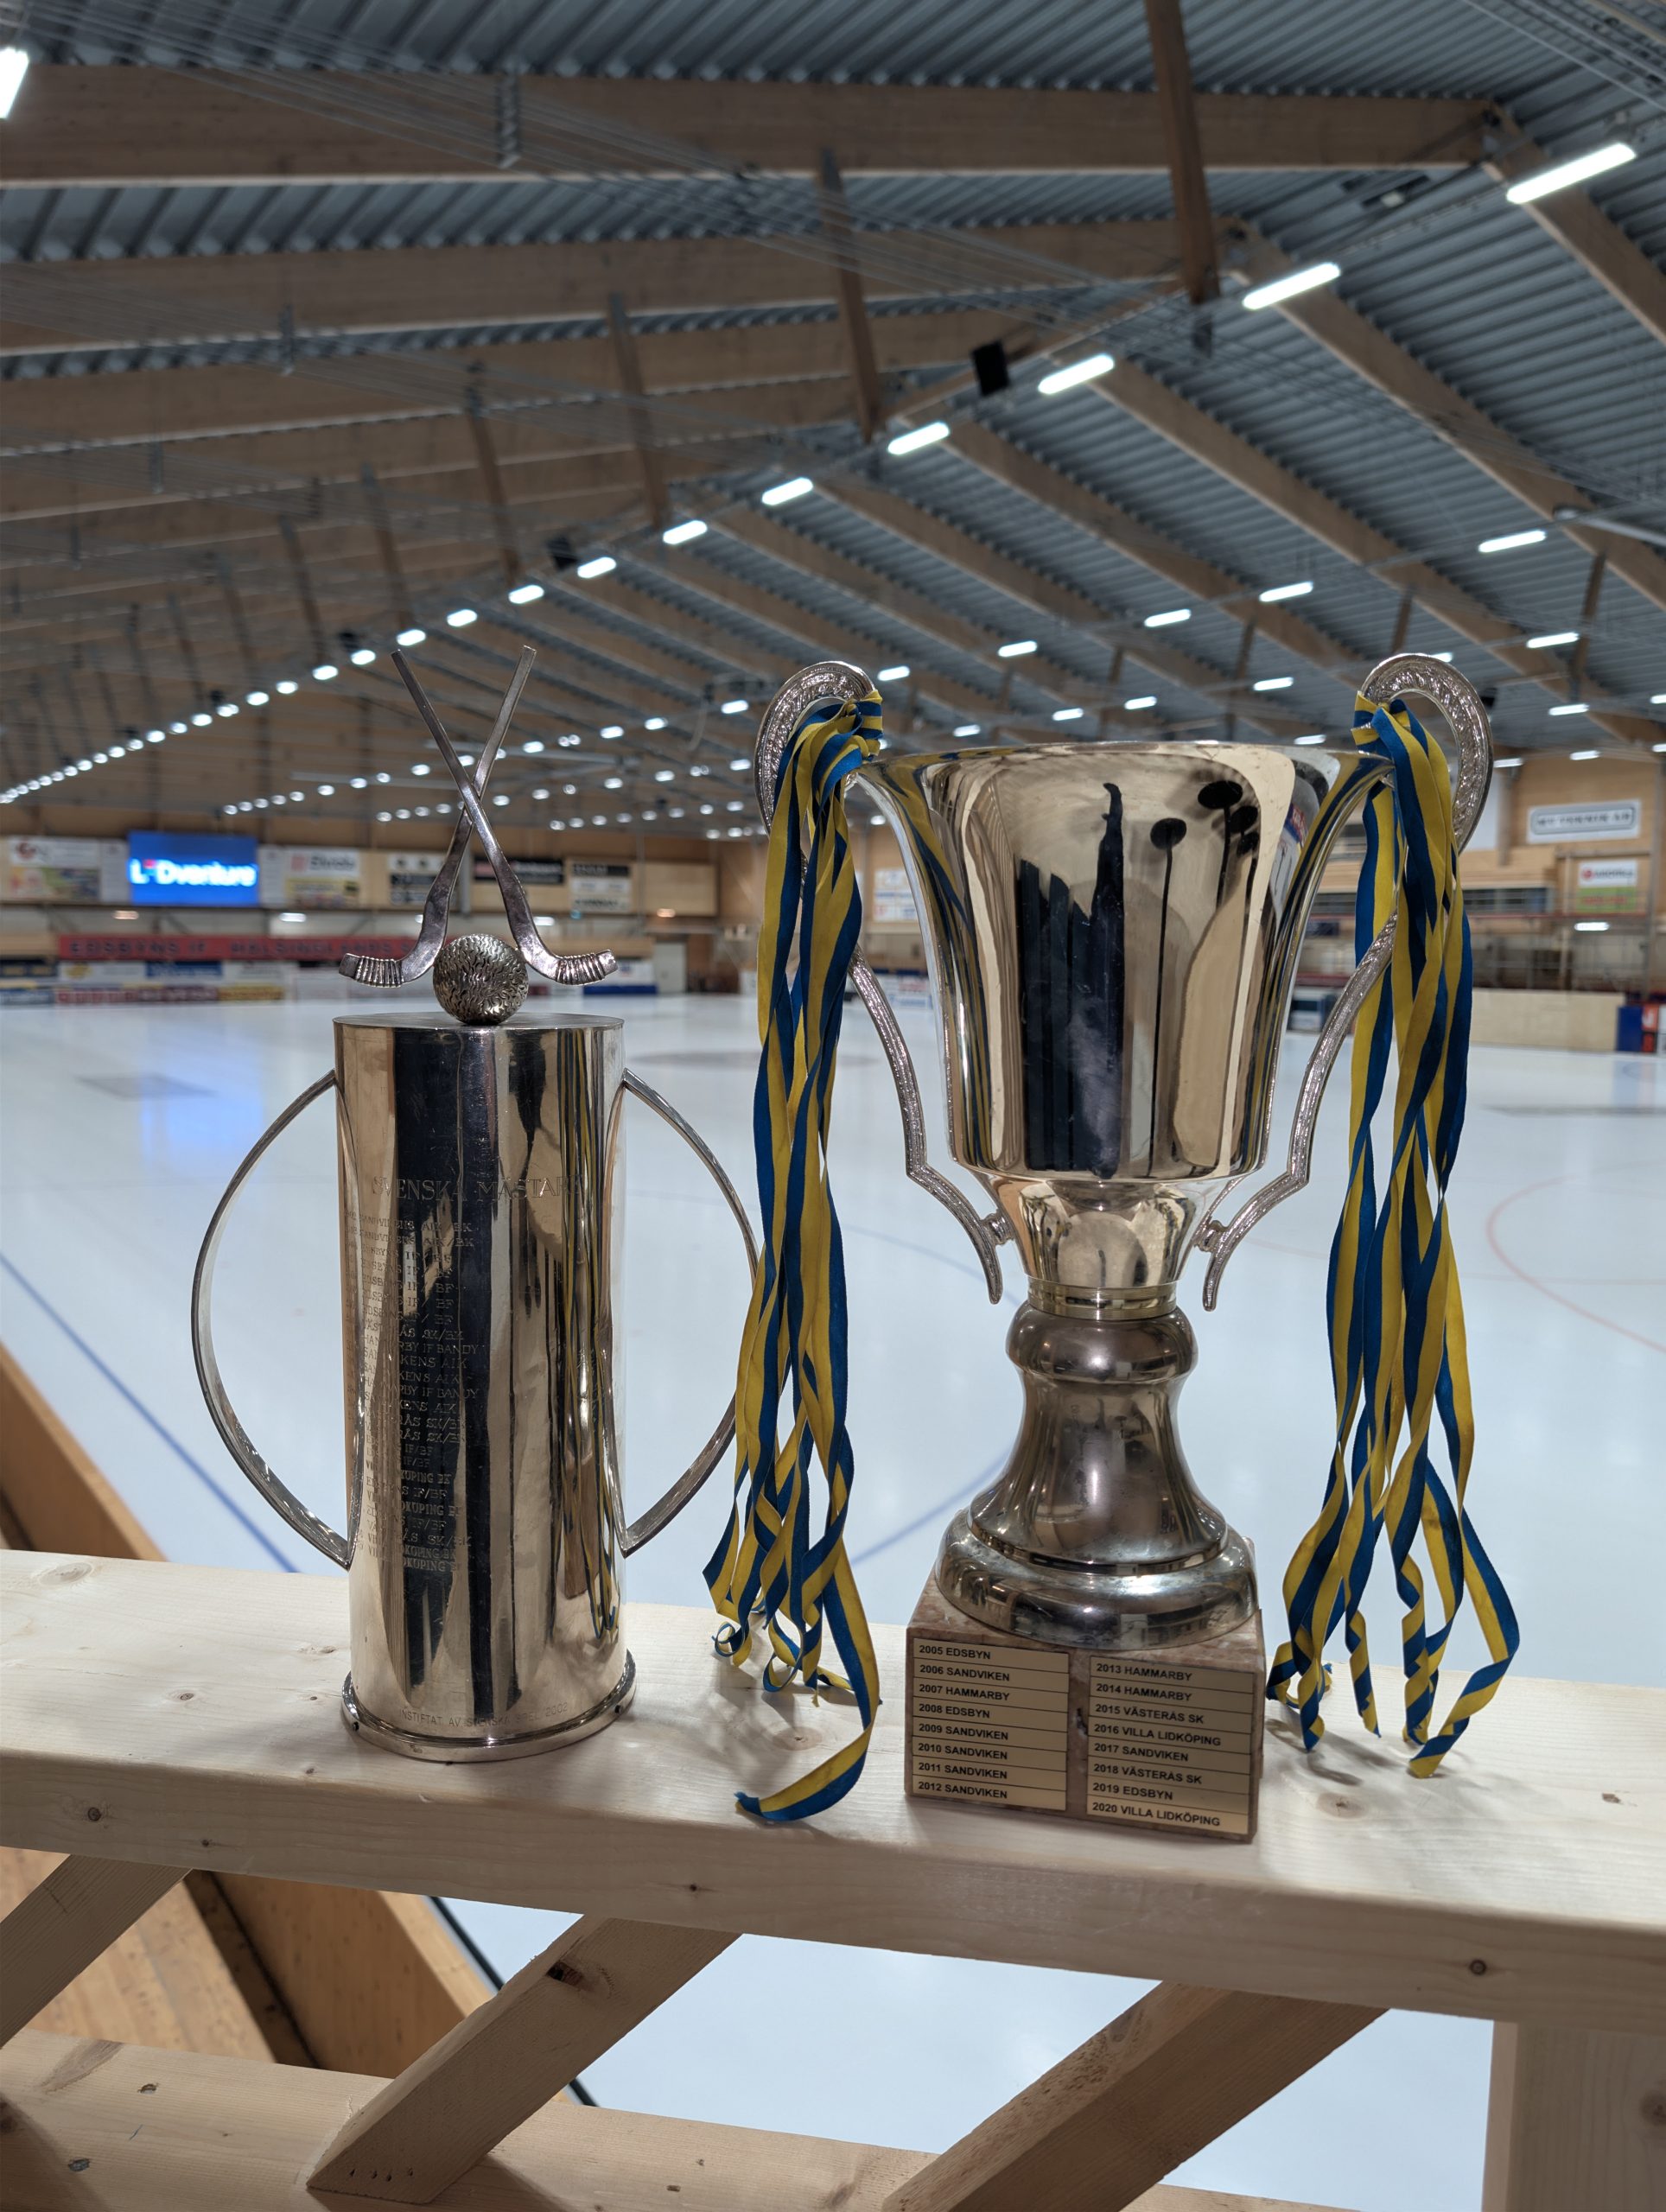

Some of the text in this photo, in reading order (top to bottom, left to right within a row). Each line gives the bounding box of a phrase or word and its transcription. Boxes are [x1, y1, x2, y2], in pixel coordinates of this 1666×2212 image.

[372, 1174, 581, 1202] SVENSKA MÄSTAR
[436, 1344, 479, 1355] BANDY
[919, 1645, 991, 1660] 2005 EDSBYN
[919, 1664, 1010, 1681] 2006 SANDVIKEN
[1097, 1663, 1192, 1681] 2013 HAMMARBY
[919, 1684, 1010, 1701] 2007 HAMMARBY
[1096, 1683, 1192, 1701] 2014 HAMMARBY
[398, 1706, 443, 1726] INSTIFTAT
[448, 1716, 461, 1728] AV
[465, 1713, 512, 1728] SVENSKA
[545, 1700, 569, 1718] 2002
[919, 1704, 990, 1719] 2008 EDSBYN
[1095, 1704, 1204, 1724] 2015 VÄSTERÅS SK
[919, 1724, 1008, 1740] 2009 SANDVIKEN
[1094, 1724, 1221, 1746] 2016 VILLA LIDKÖPING
[919, 1743, 1008, 1759] 2010 SANDVIKEN
[1094, 1743, 1189, 1762] 2017 SANDVIKEN
[919, 1762, 1008, 1779] 2011 SANDVIKEN
[1094, 1764, 1202, 1785] 2018 VÄSTERÅS SK
[919, 1782, 1008, 1799] 2012 SANDVIKEN
[1093, 1783, 1173, 1801] 2019 EDSBYN
[1092, 1802, 1220, 1827] 2020 VILLA LIDKÖPING
